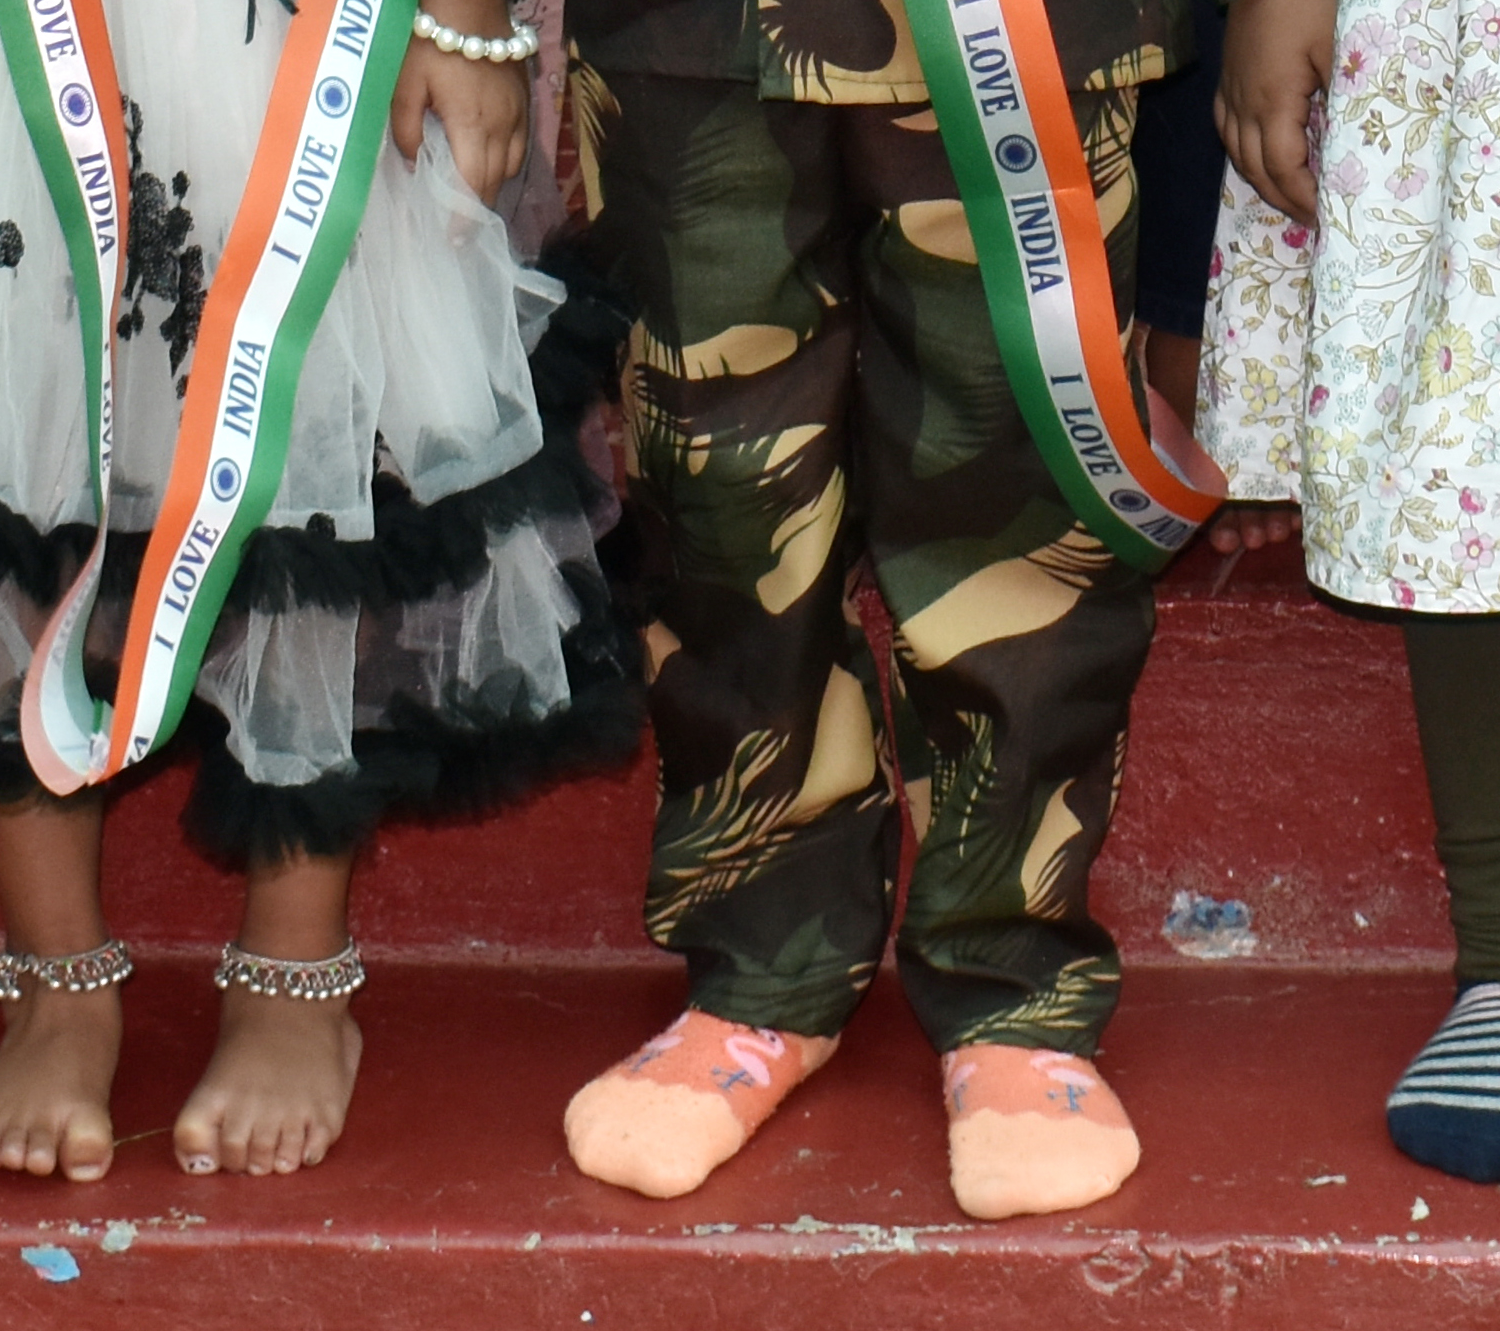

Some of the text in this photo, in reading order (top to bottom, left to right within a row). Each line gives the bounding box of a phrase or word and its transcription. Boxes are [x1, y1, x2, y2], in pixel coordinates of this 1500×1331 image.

[75, 151, 116, 258] INDIA
[285, 136, 337, 230] LOVE
[962, 23, 1021, 118] LOVE
[1011, 192, 1064, 297] INDIA
[271, 242, 302, 265] I
[1051, 372, 1084, 386] I
[1061, 407, 1123, 477] LOVE
[153, 338, 267, 652] I LOVE INDIA
